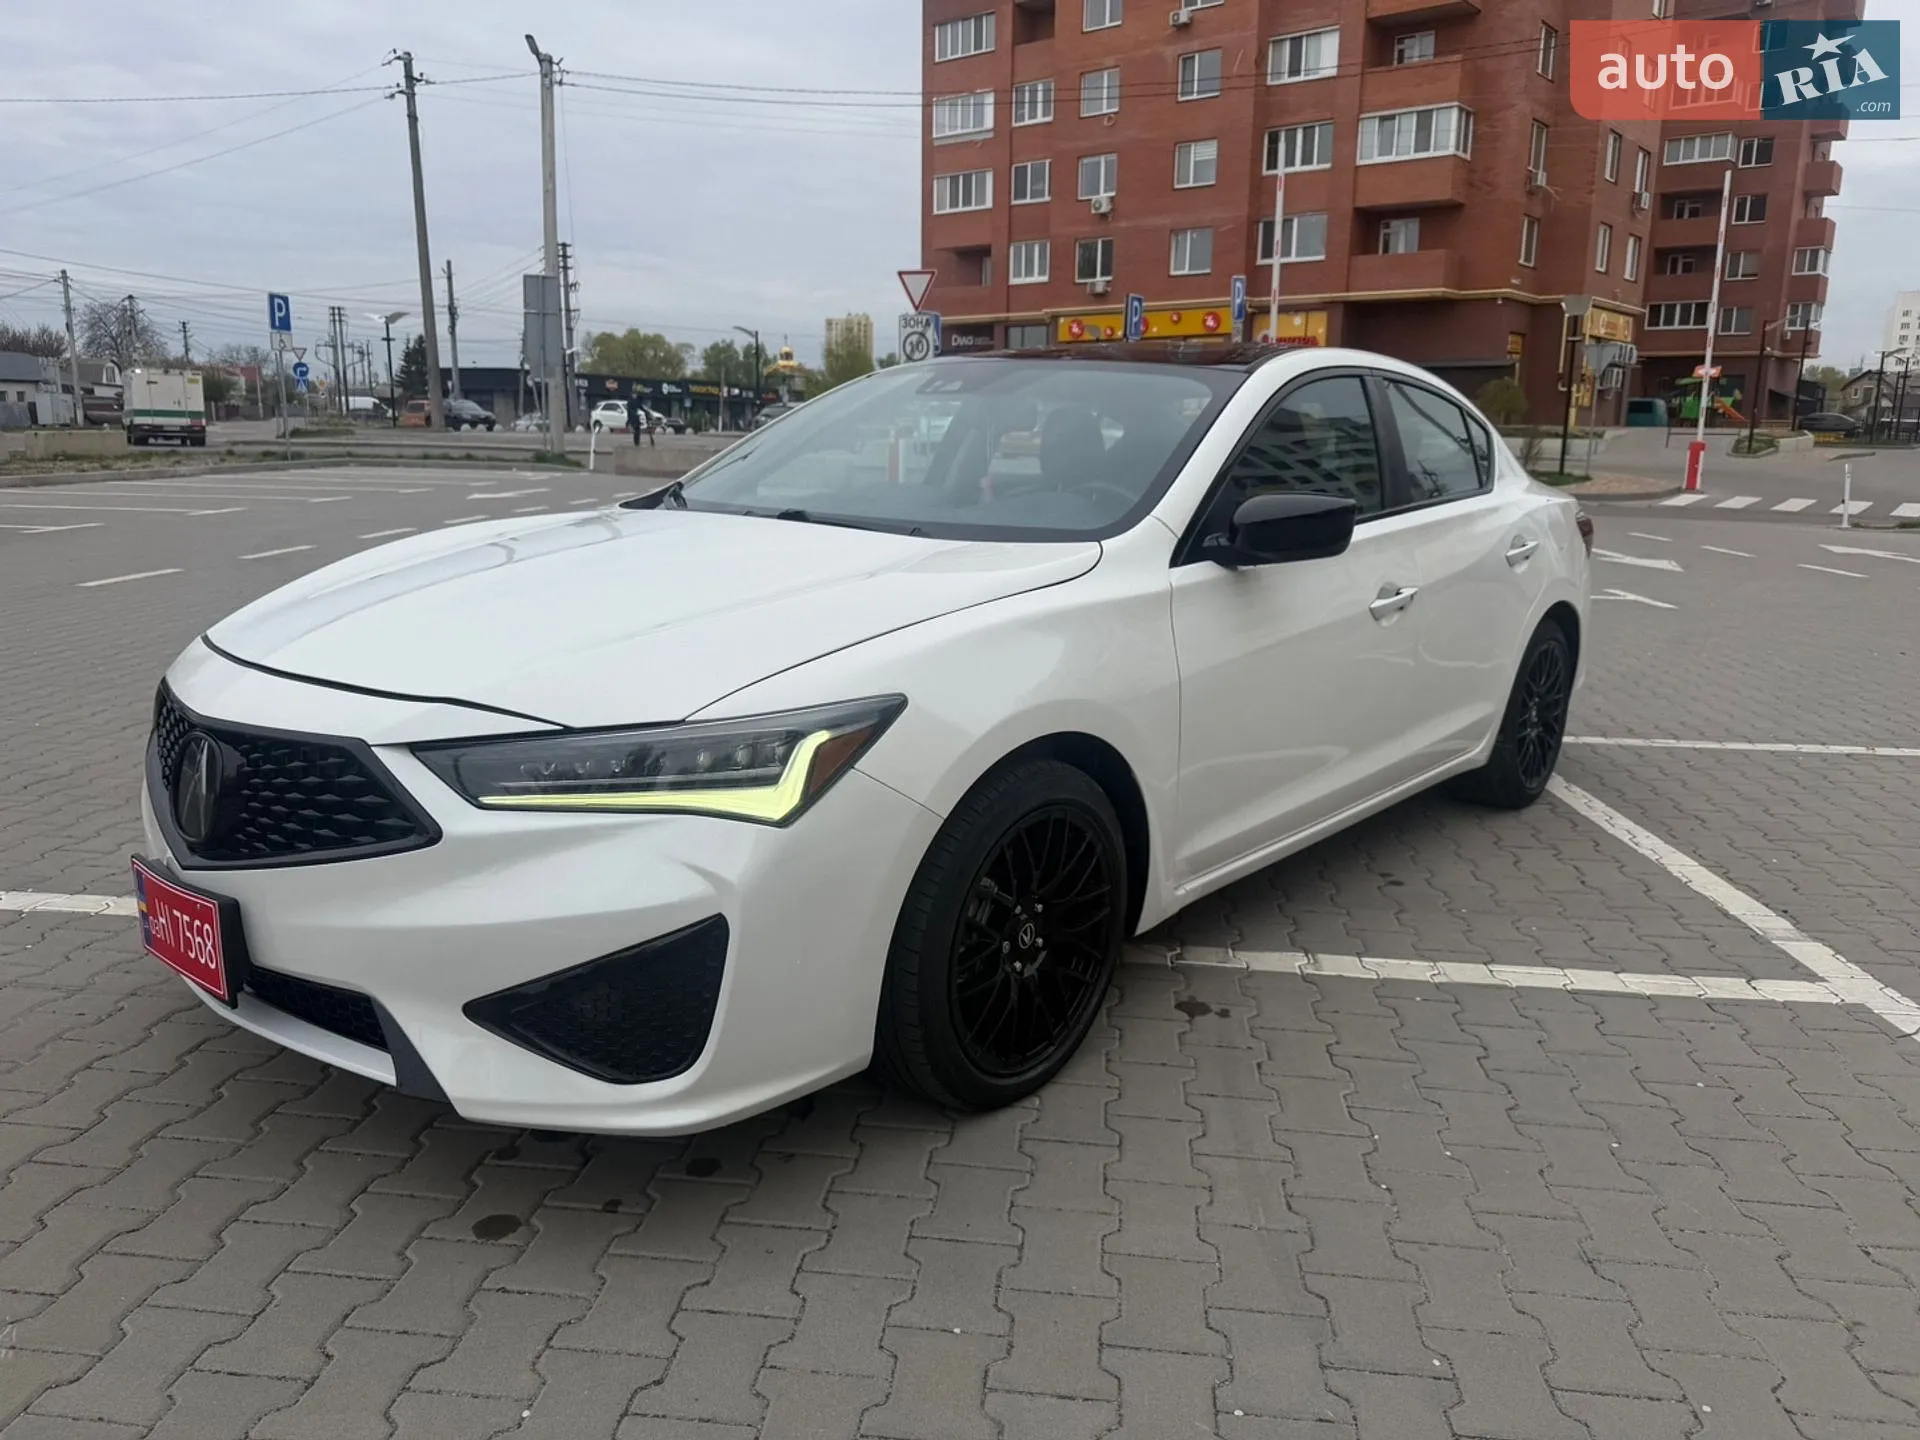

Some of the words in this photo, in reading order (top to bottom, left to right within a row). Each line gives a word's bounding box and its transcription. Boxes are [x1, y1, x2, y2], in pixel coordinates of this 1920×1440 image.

[274, 297, 286, 327] P
[1234, 281, 1243, 320] P
[902, 316, 931, 329] ЗОНА
[1132, 301, 1141, 334] P
[172, 908, 216, 969] 7568
